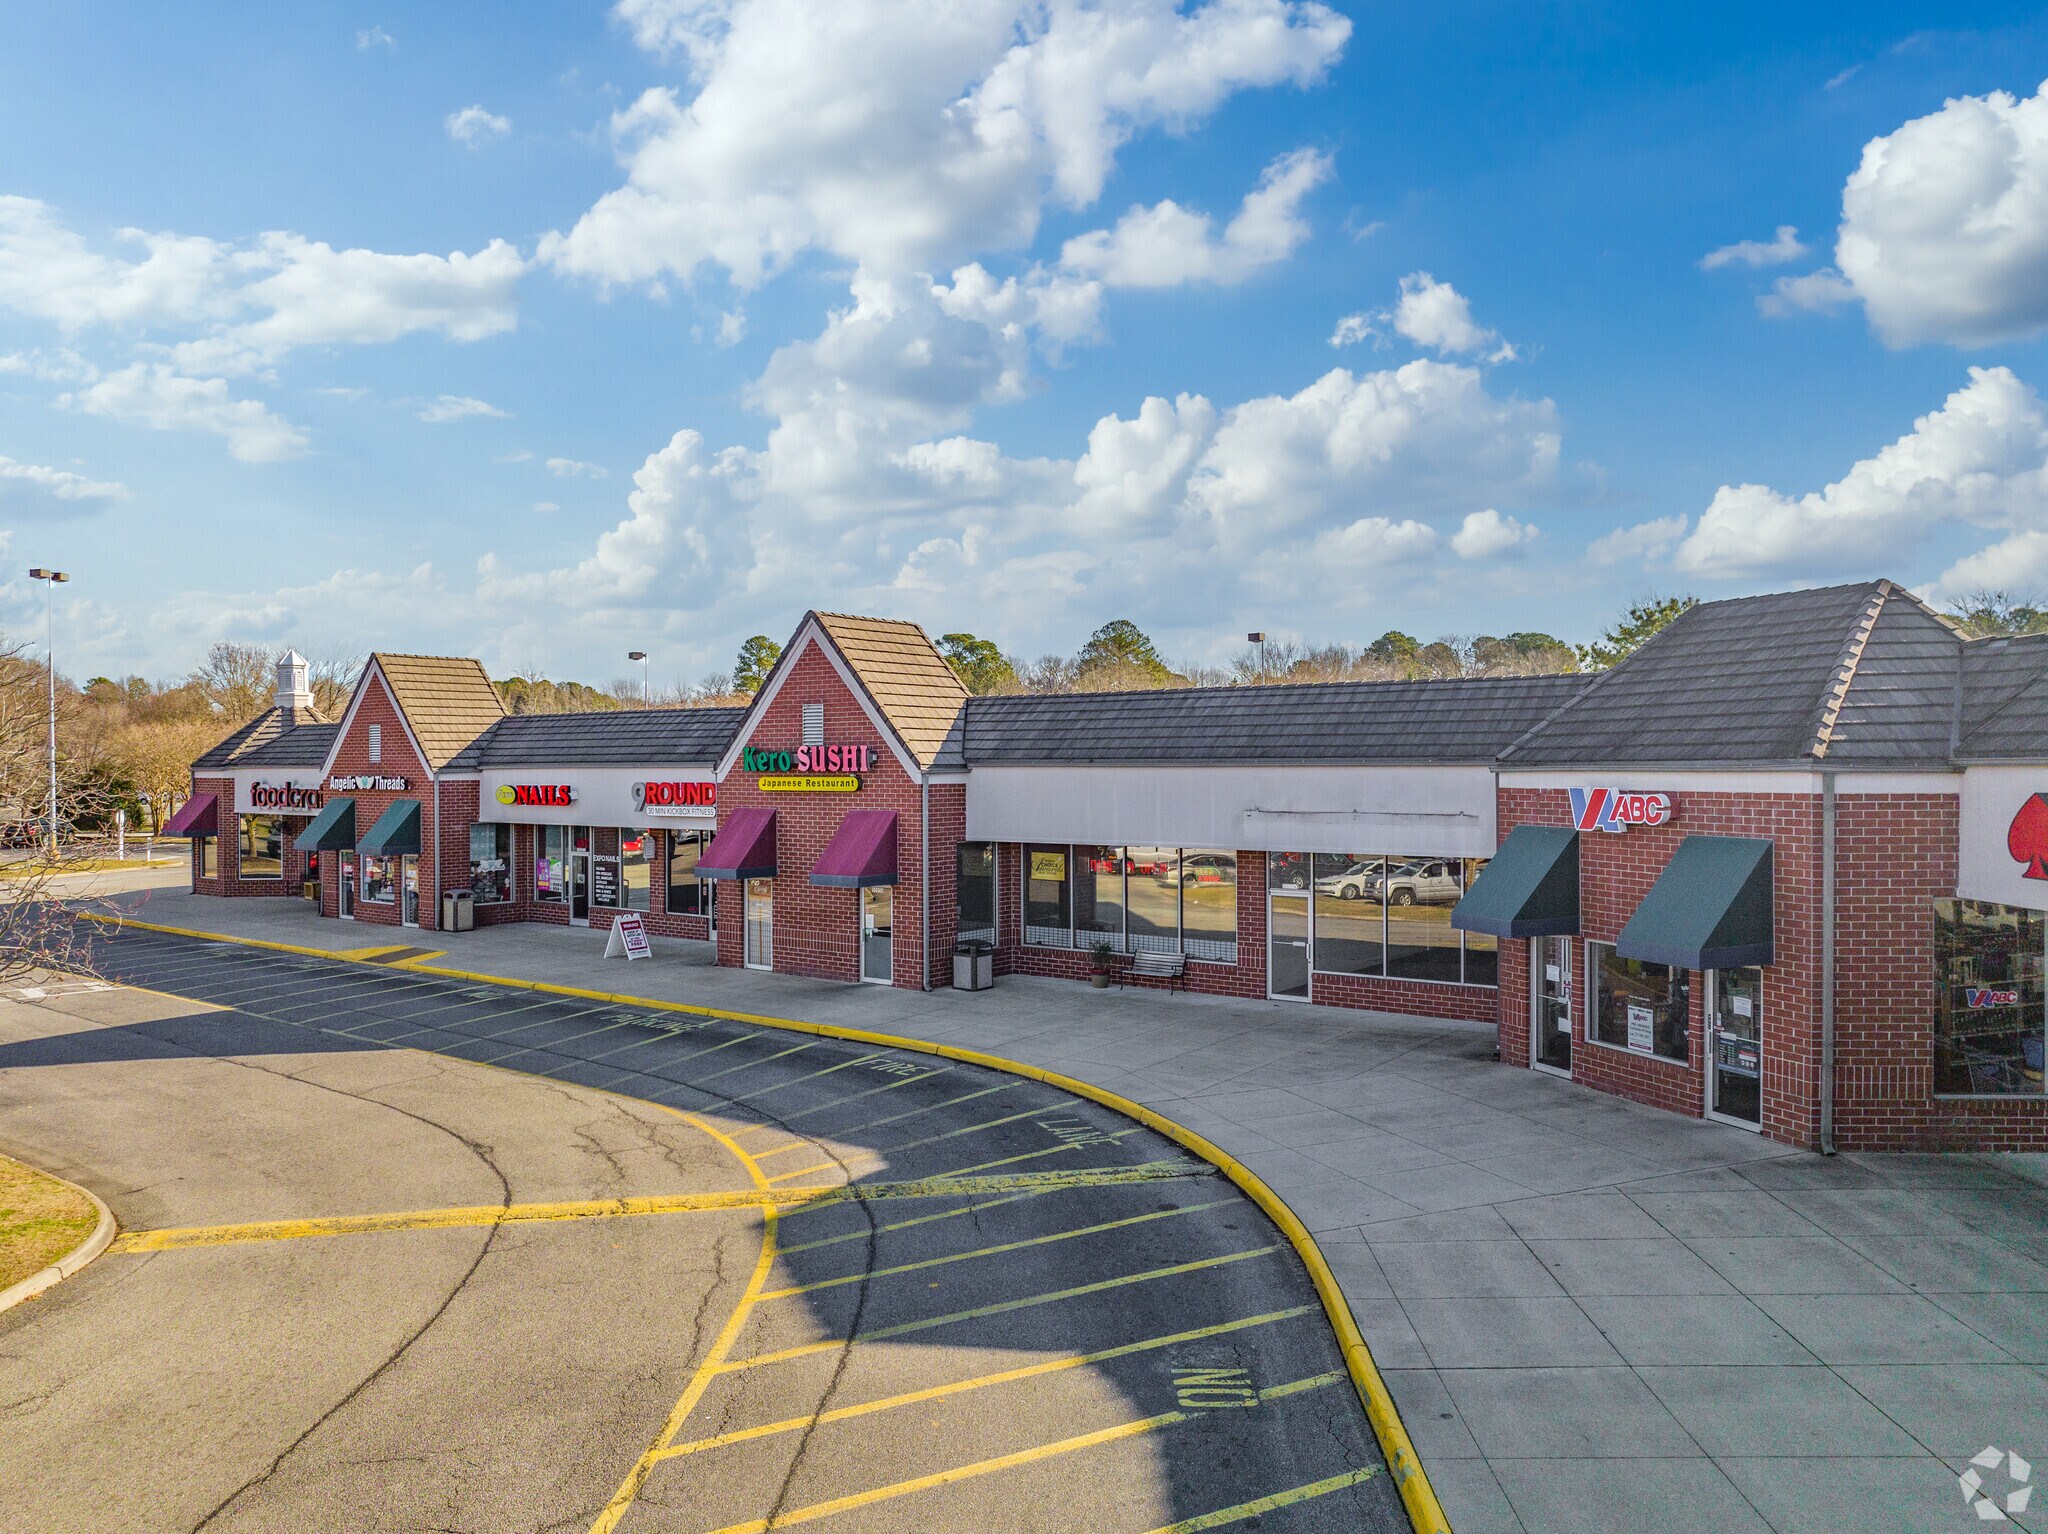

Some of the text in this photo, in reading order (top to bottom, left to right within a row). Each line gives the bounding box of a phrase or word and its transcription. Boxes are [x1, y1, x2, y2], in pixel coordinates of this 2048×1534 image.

[743, 745, 868, 772] Kero SUSHI
[330, 775, 405, 791] Angelic Threads
[762, 779, 855, 788] Japanese Restaurant
[516, 785, 572, 806] NAILS
[631, 782, 716, 812] 9ROUND
[647, 807, 714, 816] 30 MIN KICKBOX FITNESS
[1608, 794, 1663, 826] ABC
[605, 855, 620, 863] NAILS
[1988, 990, 2018, 1005] ABC
[853, 1059, 931, 1076] FIRE
[1037, 1119, 1123, 1149] LANE
[1171, 1368, 1259, 1408] NO
